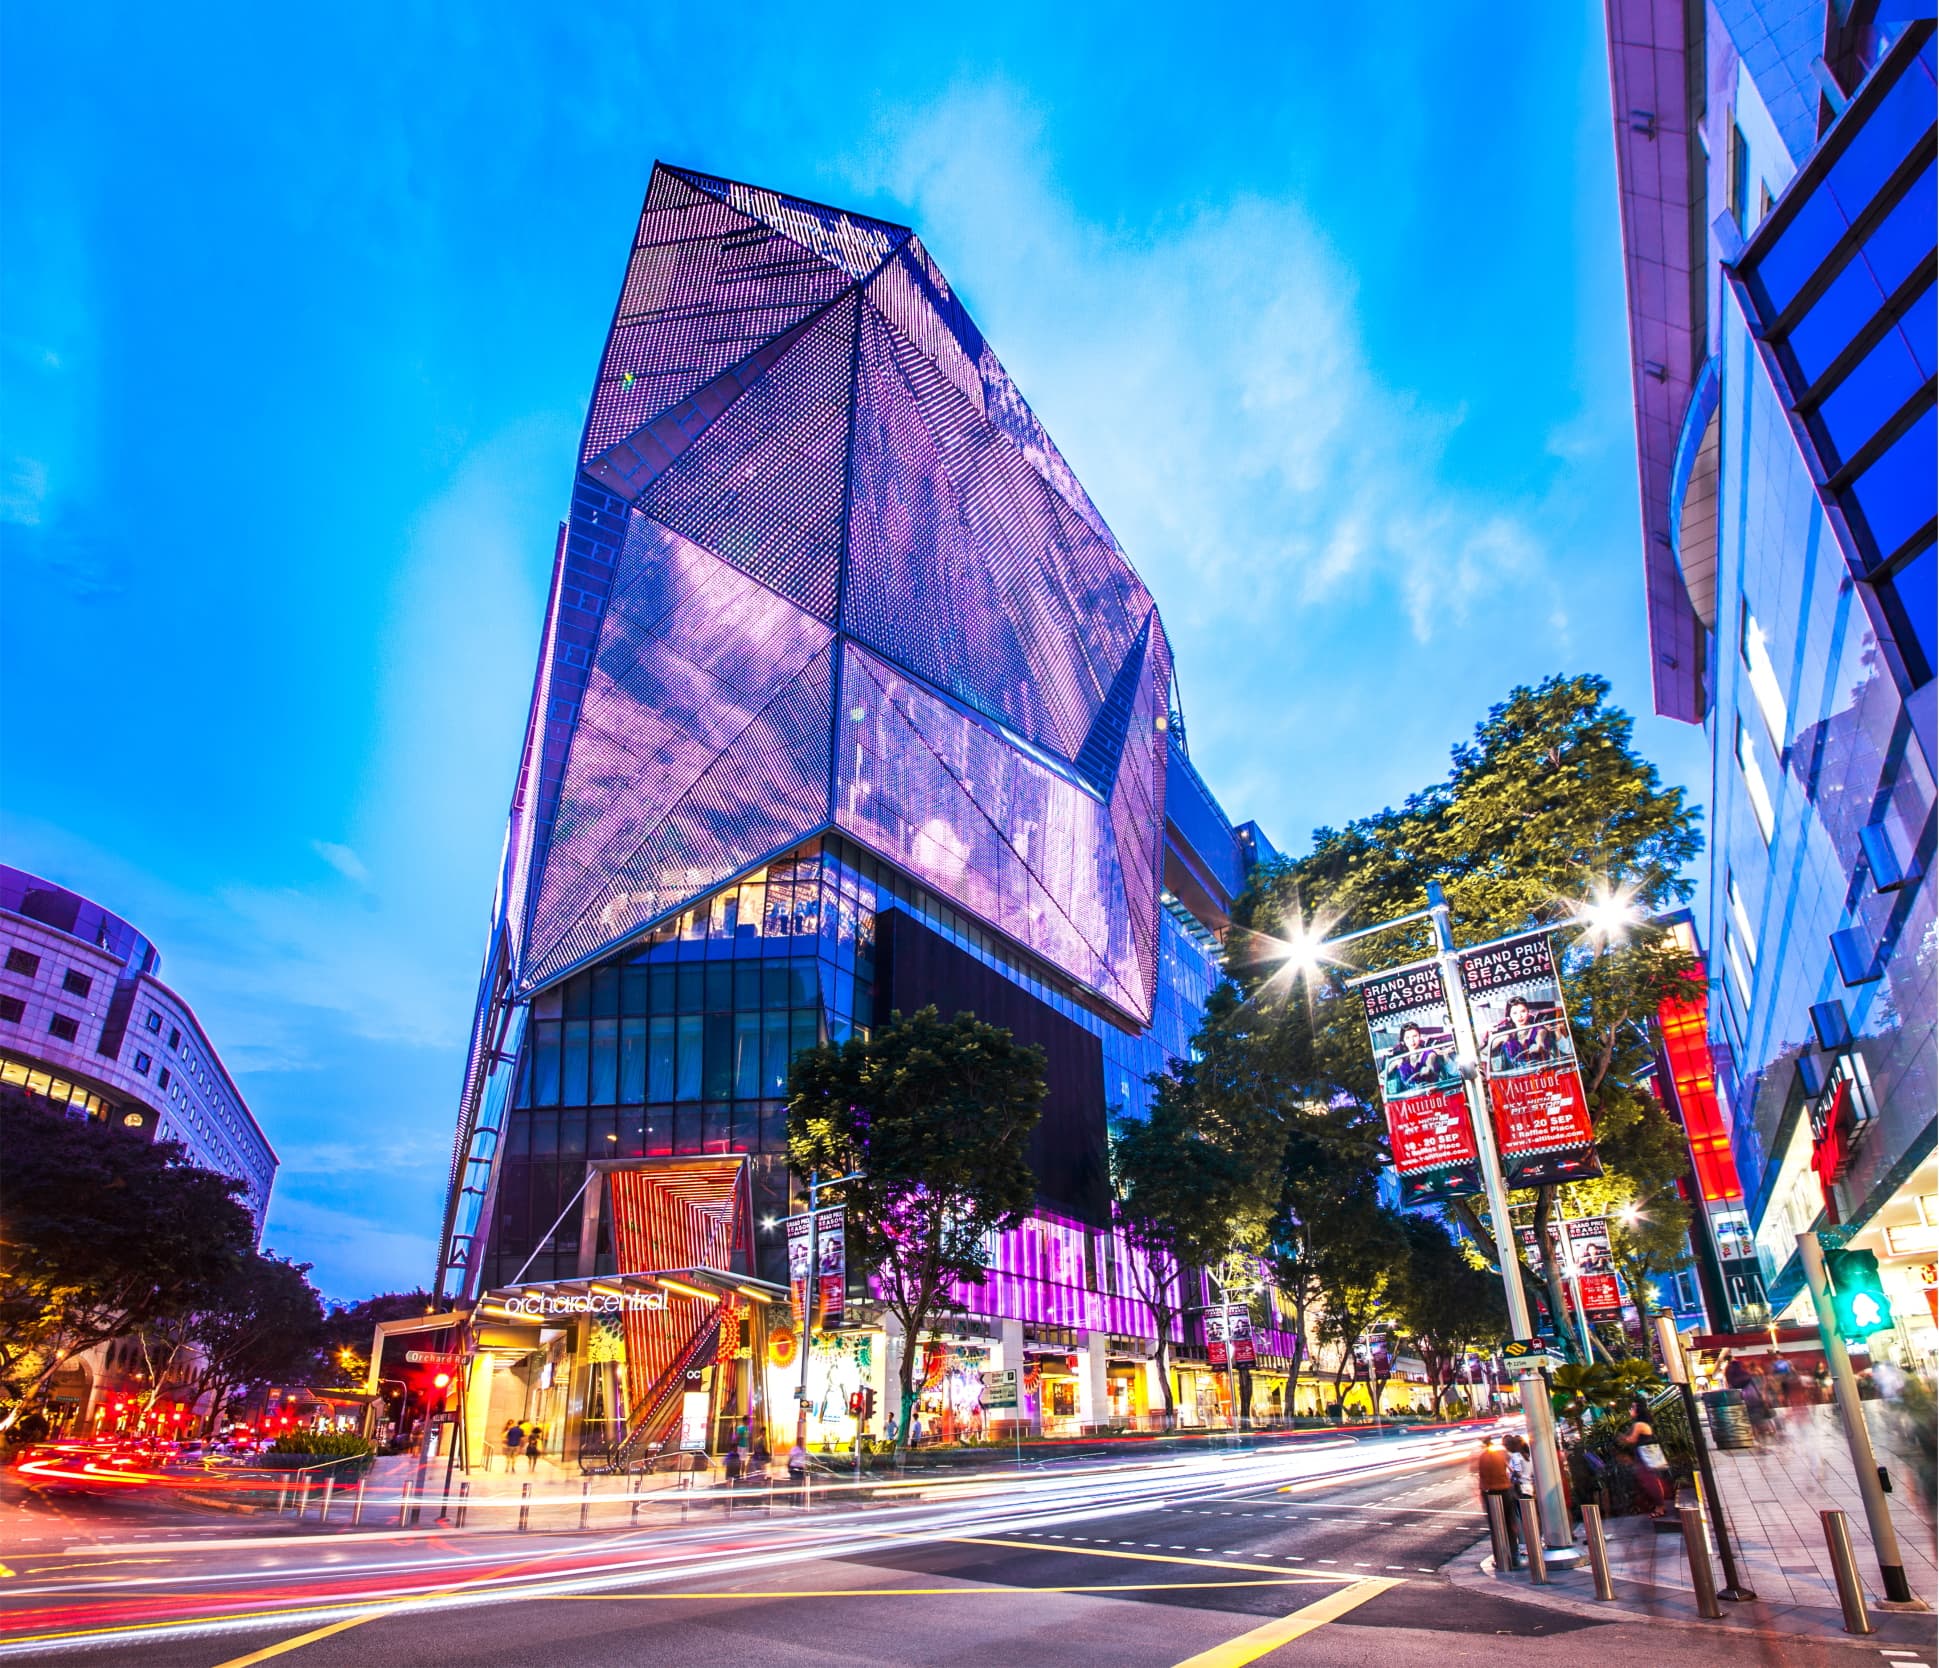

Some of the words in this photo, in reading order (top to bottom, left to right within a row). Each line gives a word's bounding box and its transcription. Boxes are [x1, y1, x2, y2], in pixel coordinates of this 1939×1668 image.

[1465, 950, 1511, 971] GRAND
[1515, 941, 1547, 958] PRIX
[1467, 952, 1550, 981] SEASON
[1469, 963, 1551, 989] SINGAPORE
[1364, 978, 1405, 998] GRAND
[1408, 969, 1438, 985] PRIX
[1366, 980, 1440, 1008] SEASON
[1368, 990, 1441, 1015] SINGAPORE
[1511, 1106, 1527, 1115] PIT
[1519, 1128, 1548, 1138] Raffles
[1551, 1124, 1575, 1133] Place
[1533, 1119, 1547, 1128] 20
[1550, 1115, 1573, 1125] SEP
[1438, 1133, 1459, 1143] SEP
[1506, 1131, 1584, 1147] www.1-altitude.com
[504, 1288, 670, 1314] orchardcentral
[411, 1352, 452, 1363] Orchard
[455, 1356, 466, 1365] Rd
[686, 1370, 701, 1380] OC
